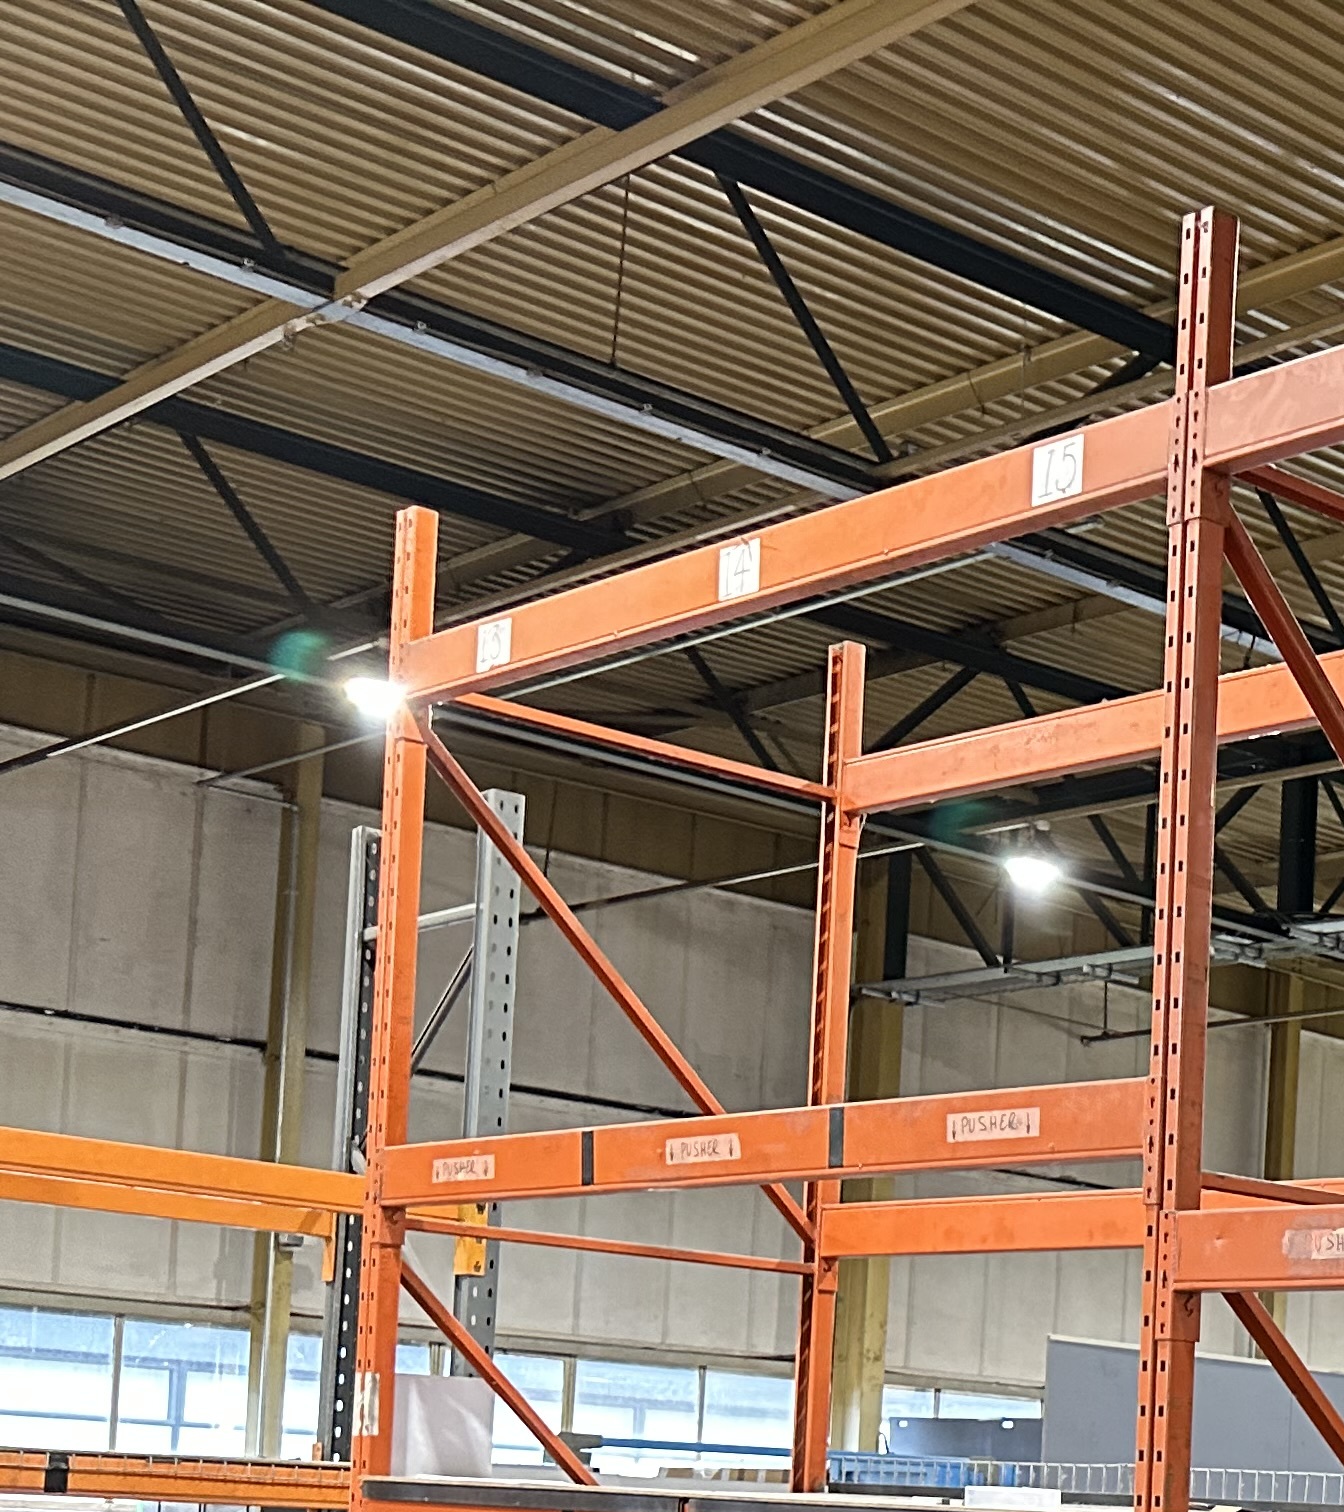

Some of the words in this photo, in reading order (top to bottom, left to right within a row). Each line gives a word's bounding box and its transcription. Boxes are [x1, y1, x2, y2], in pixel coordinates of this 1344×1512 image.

[1038, 442, 1077, 498] 15
[722, 546, 752, 597] 14
[479, 623, 502, 664] 13
[961, 1112, 1018, 1135] PUSHER
[680, 1139, 721, 1158] PUSHER
[442, 1163, 476, 1177] PUSHER
